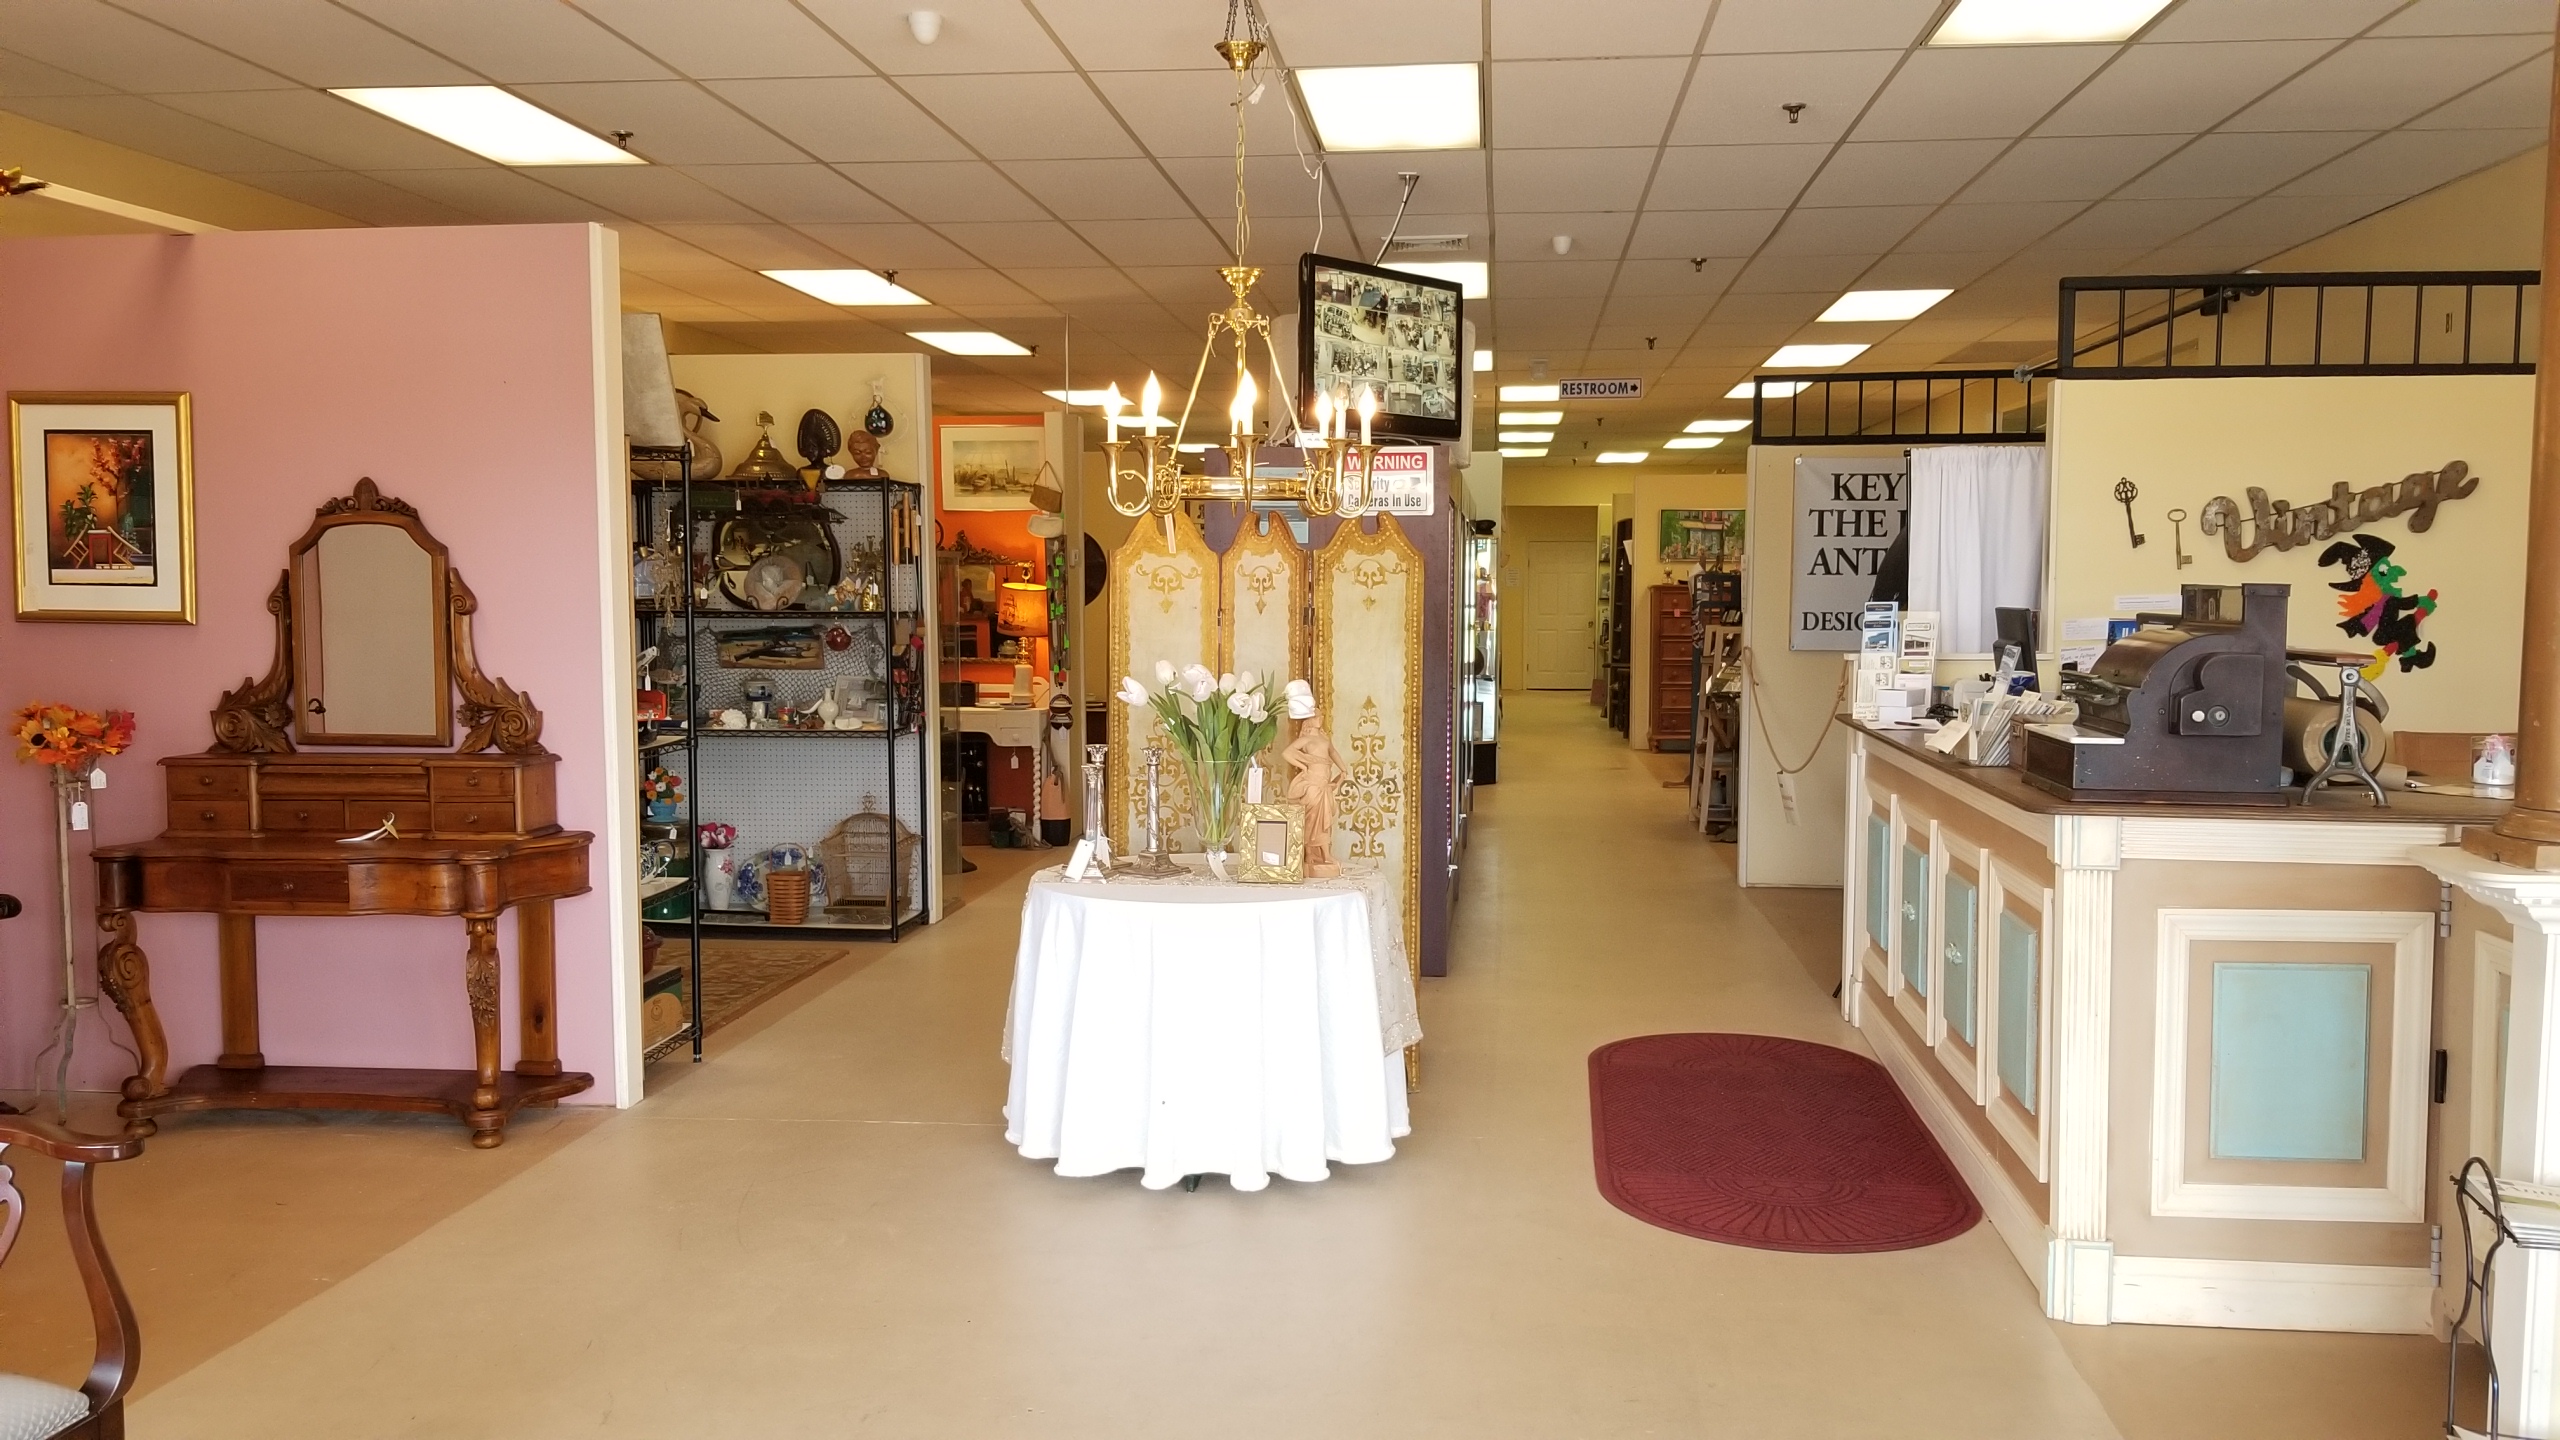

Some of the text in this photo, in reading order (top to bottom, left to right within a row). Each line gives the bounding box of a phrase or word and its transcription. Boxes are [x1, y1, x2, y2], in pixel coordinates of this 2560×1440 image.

[1562, 382, 1628, 395] RESTROOM
[1347, 455, 1423, 470] WRNING
[1348, 476, 1389, 493] Serity
[1348, 494, 1421, 507] Caeras In Use
[2201, 460, 2480, 563] Vintage
[1808, 508, 1888, 538] THE
